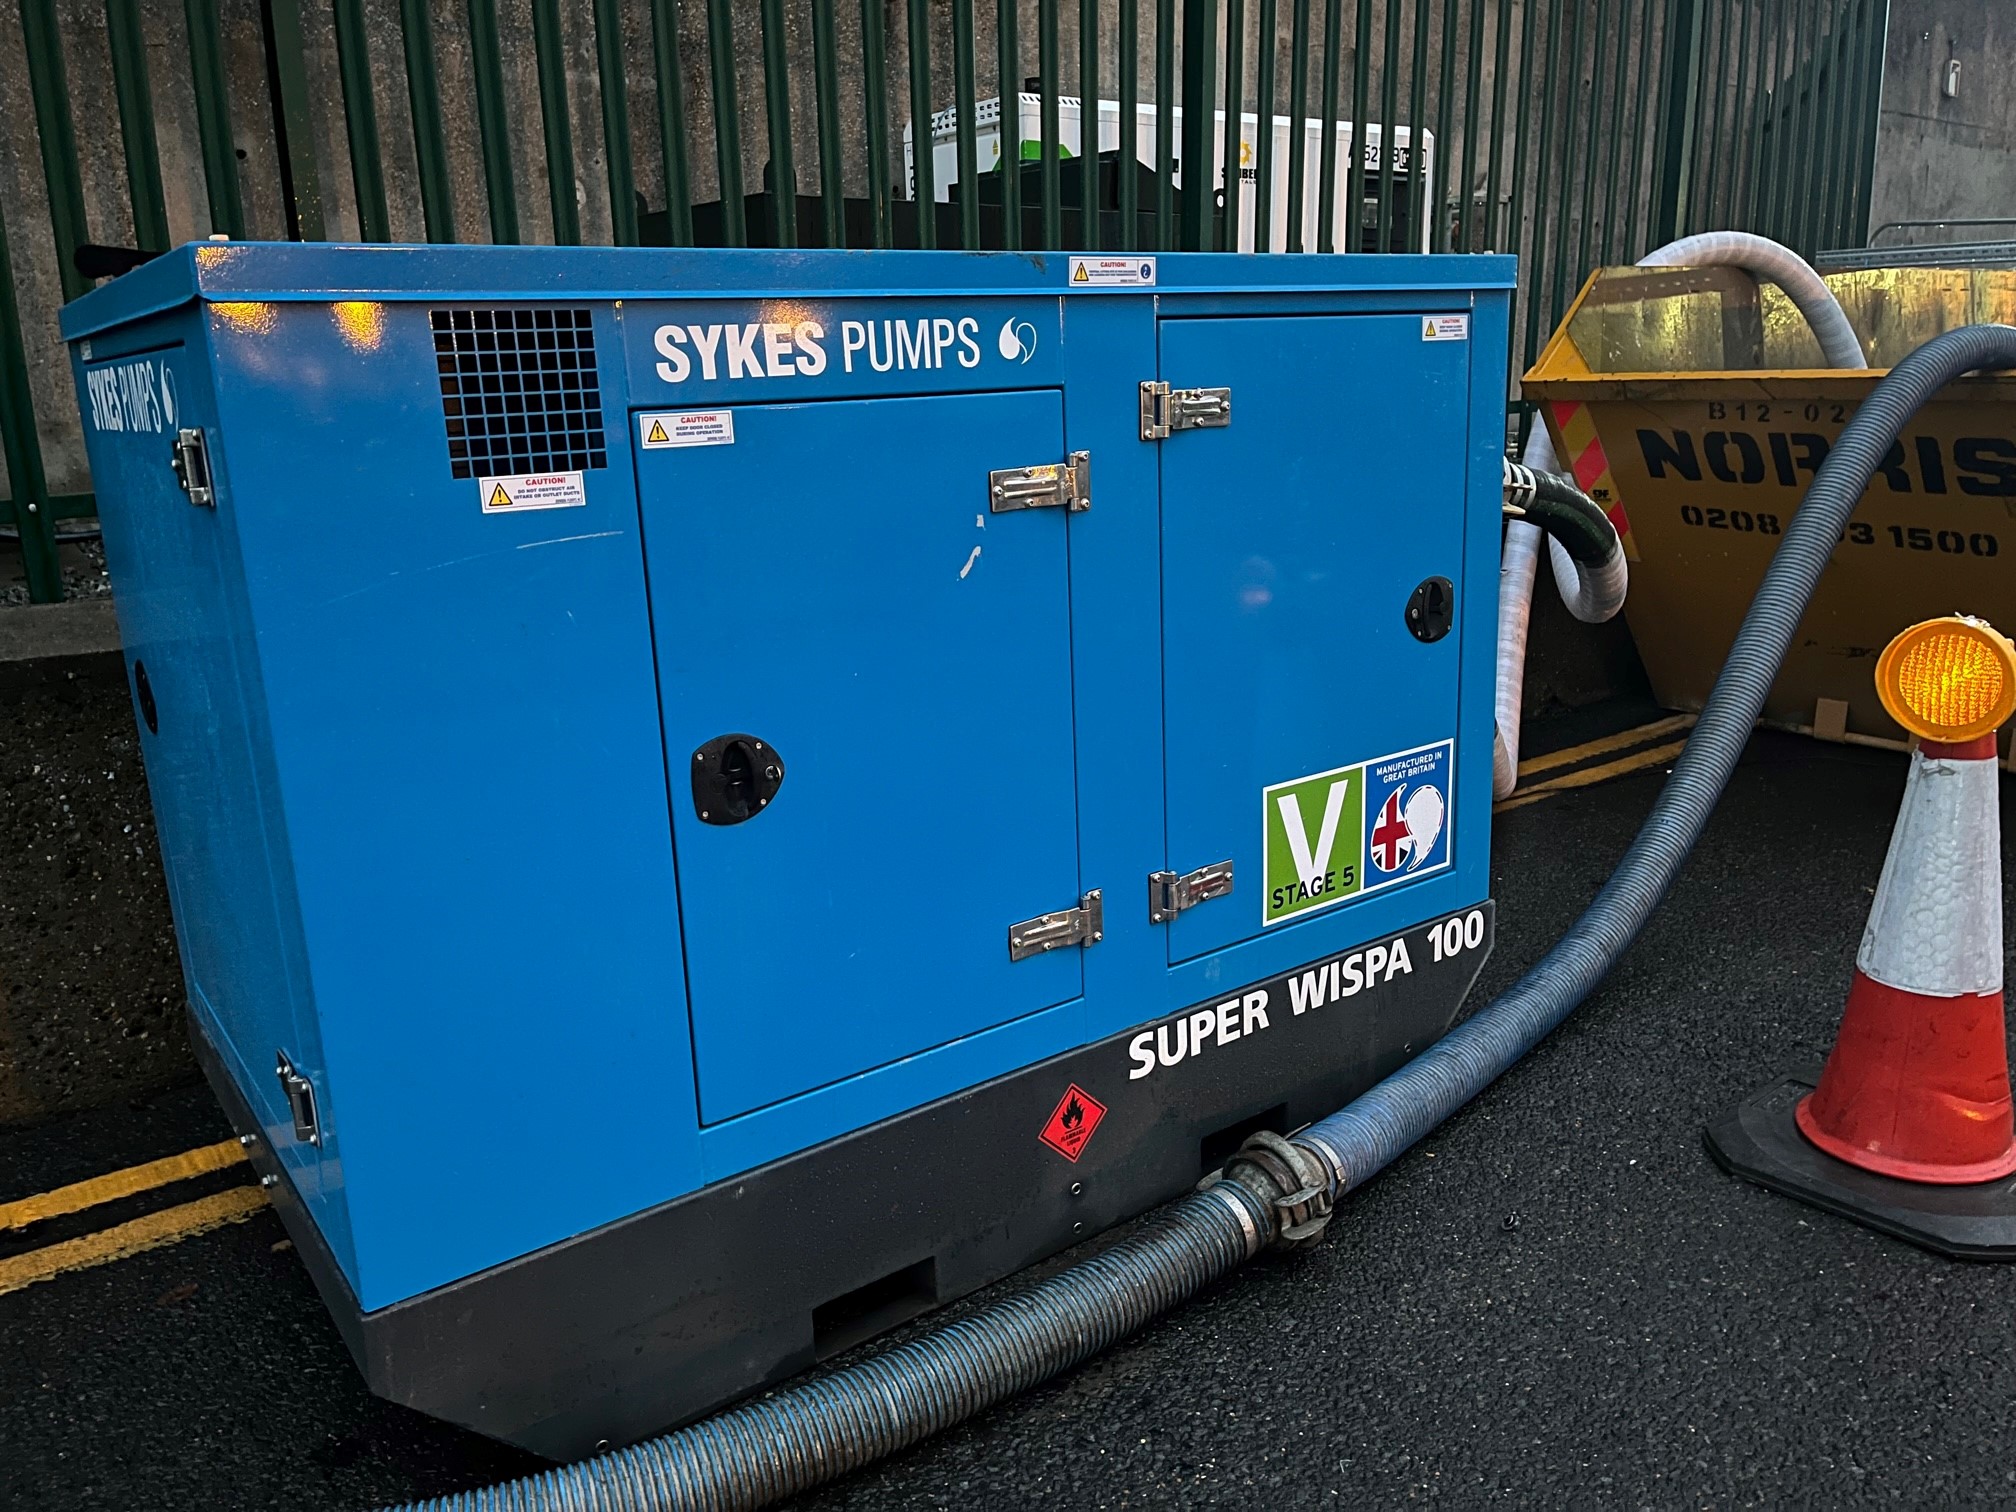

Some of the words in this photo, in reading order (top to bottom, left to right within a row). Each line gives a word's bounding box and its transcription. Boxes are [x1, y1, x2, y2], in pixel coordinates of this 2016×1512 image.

[653, 321, 827, 383] SYKES
[841, 317, 980, 373] PUMPS
[87, 367, 123, 432] SYKES
[118, 361, 161, 433] PUMPS
[680, 416, 717, 424] CAUTION!
[525, 477, 566, 486] CAUTION!
[1680, 505, 1781, 536] 0208
[1887, 525, 1998, 557] 1500
[1376, 754, 1433, 776] MANUFACTURED
[1434, 751, 1442, 760] IN
[1383, 770, 1406, 783] GREAT
[1408, 762, 1435, 777] BRITAIN
[1276, 779, 1349, 899] V
[1272, 872, 1336, 910] STAGE
[1343, 865, 1355, 886] 5
[1128, 989, 1270, 1080] SUPER
[1288, 937, 1413, 1016] WISPA
[1427, 909, 1485, 963] 100
